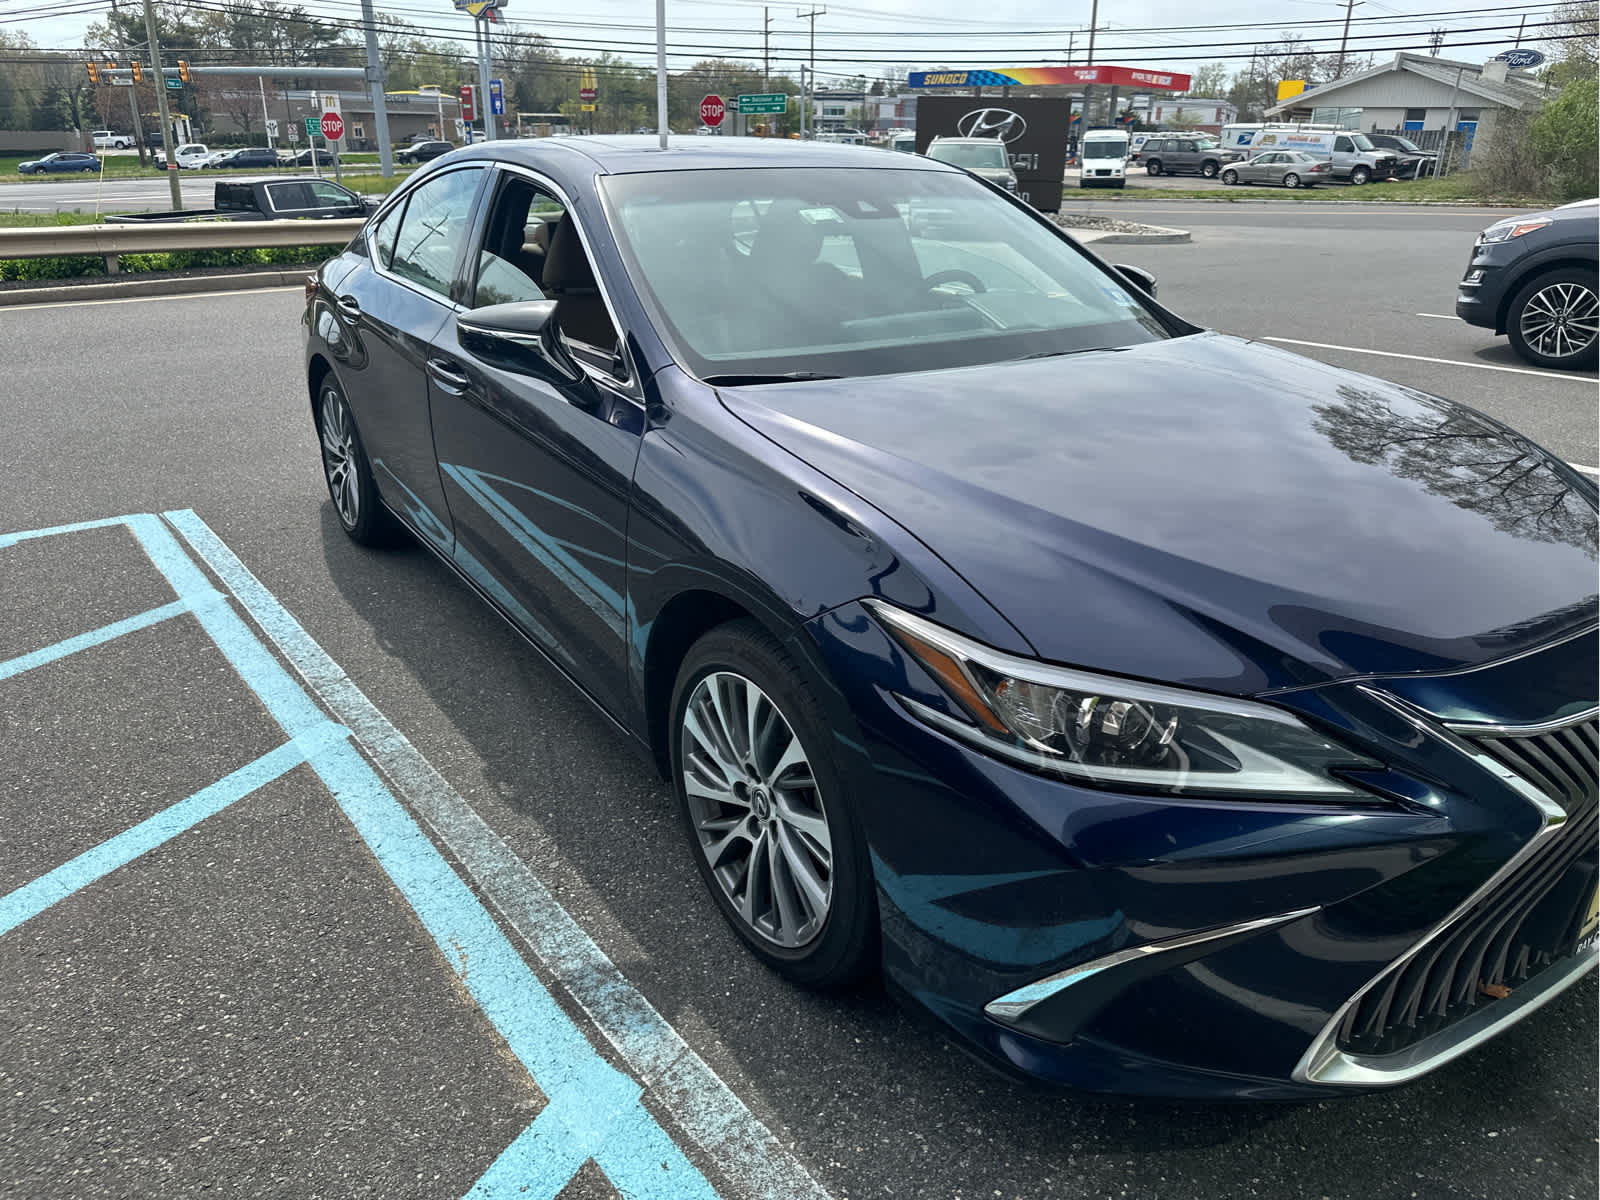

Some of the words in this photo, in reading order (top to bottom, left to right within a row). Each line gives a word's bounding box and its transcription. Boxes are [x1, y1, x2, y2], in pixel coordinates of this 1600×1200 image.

[1504, 52, 1535, 65] Ford
[923, 73, 968, 85] SUNOCO
[702, 104, 724, 117] STOP
[322, 120, 342, 132] STOP
